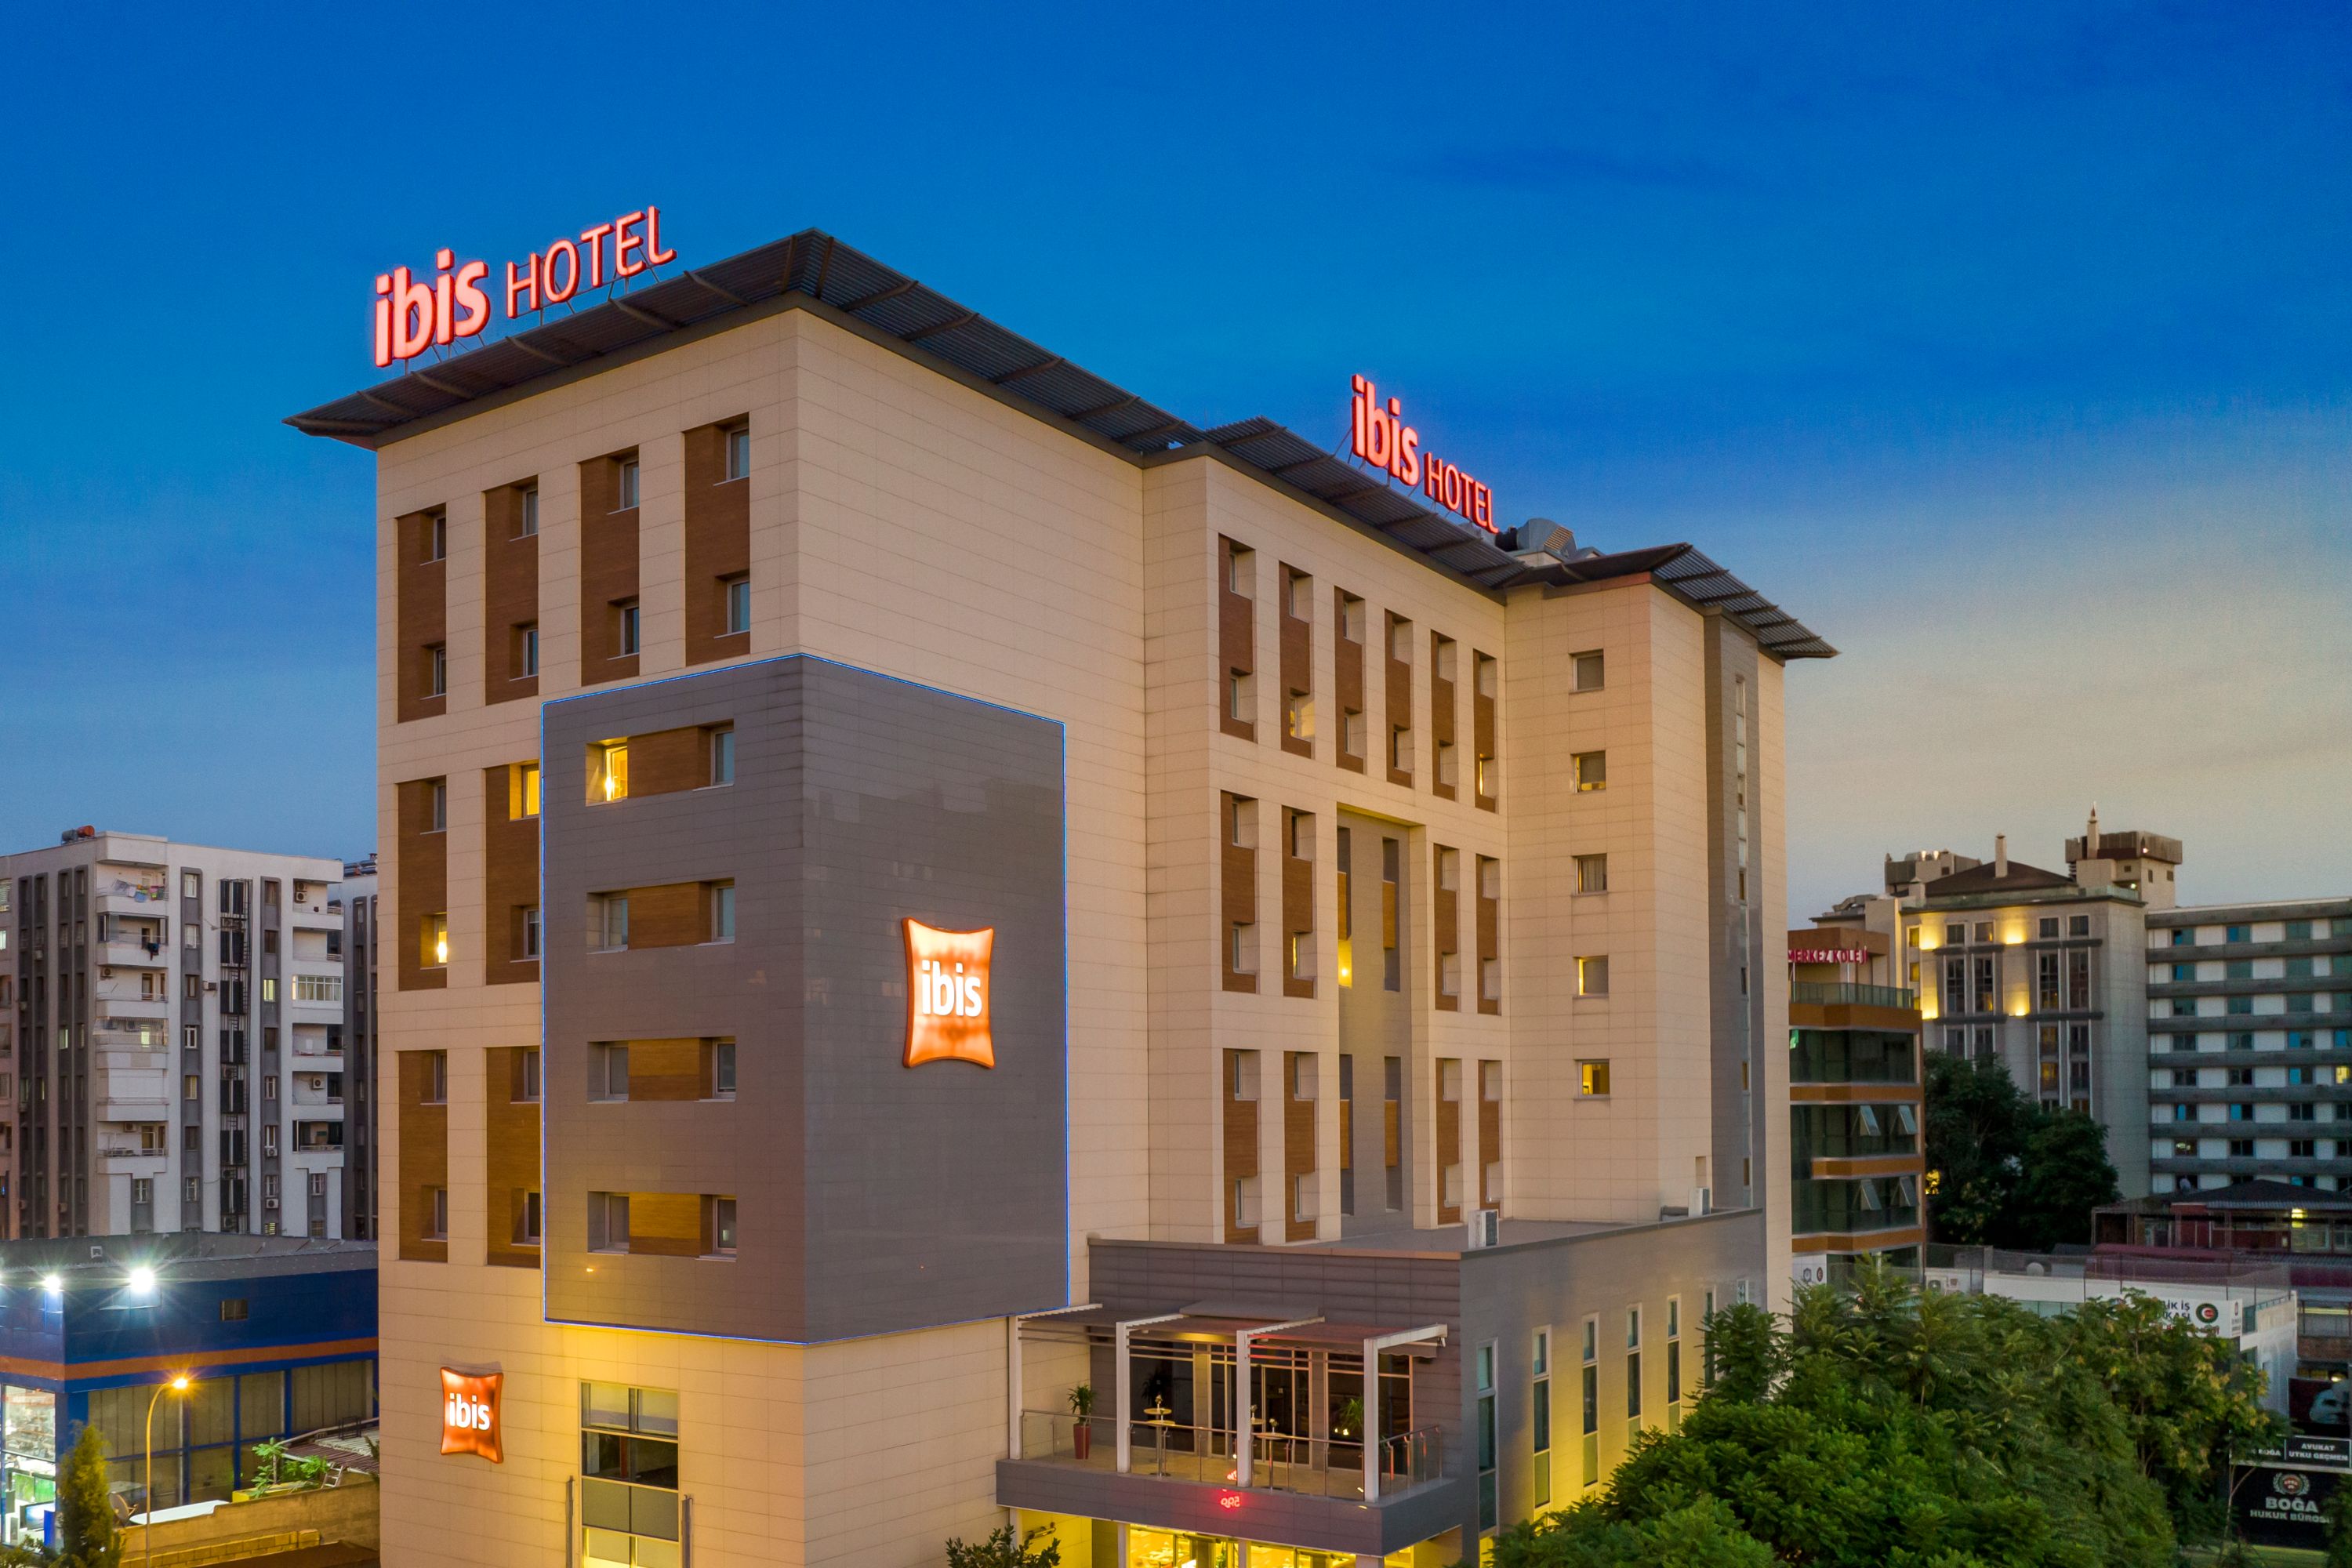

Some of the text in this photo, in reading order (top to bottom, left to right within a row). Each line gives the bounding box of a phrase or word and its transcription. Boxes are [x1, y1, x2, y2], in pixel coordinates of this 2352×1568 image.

[375, 205, 677, 368] ibis HOTEL
[1351, 373, 1500, 535] ibis HOTEL
[920, 959, 983, 1018] ibis
[448, 1392, 491, 1431] ibis
[2249, 1509, 2288, 1520] HUKUK
[2265, 1496, 2318, 1513] BOĞA
